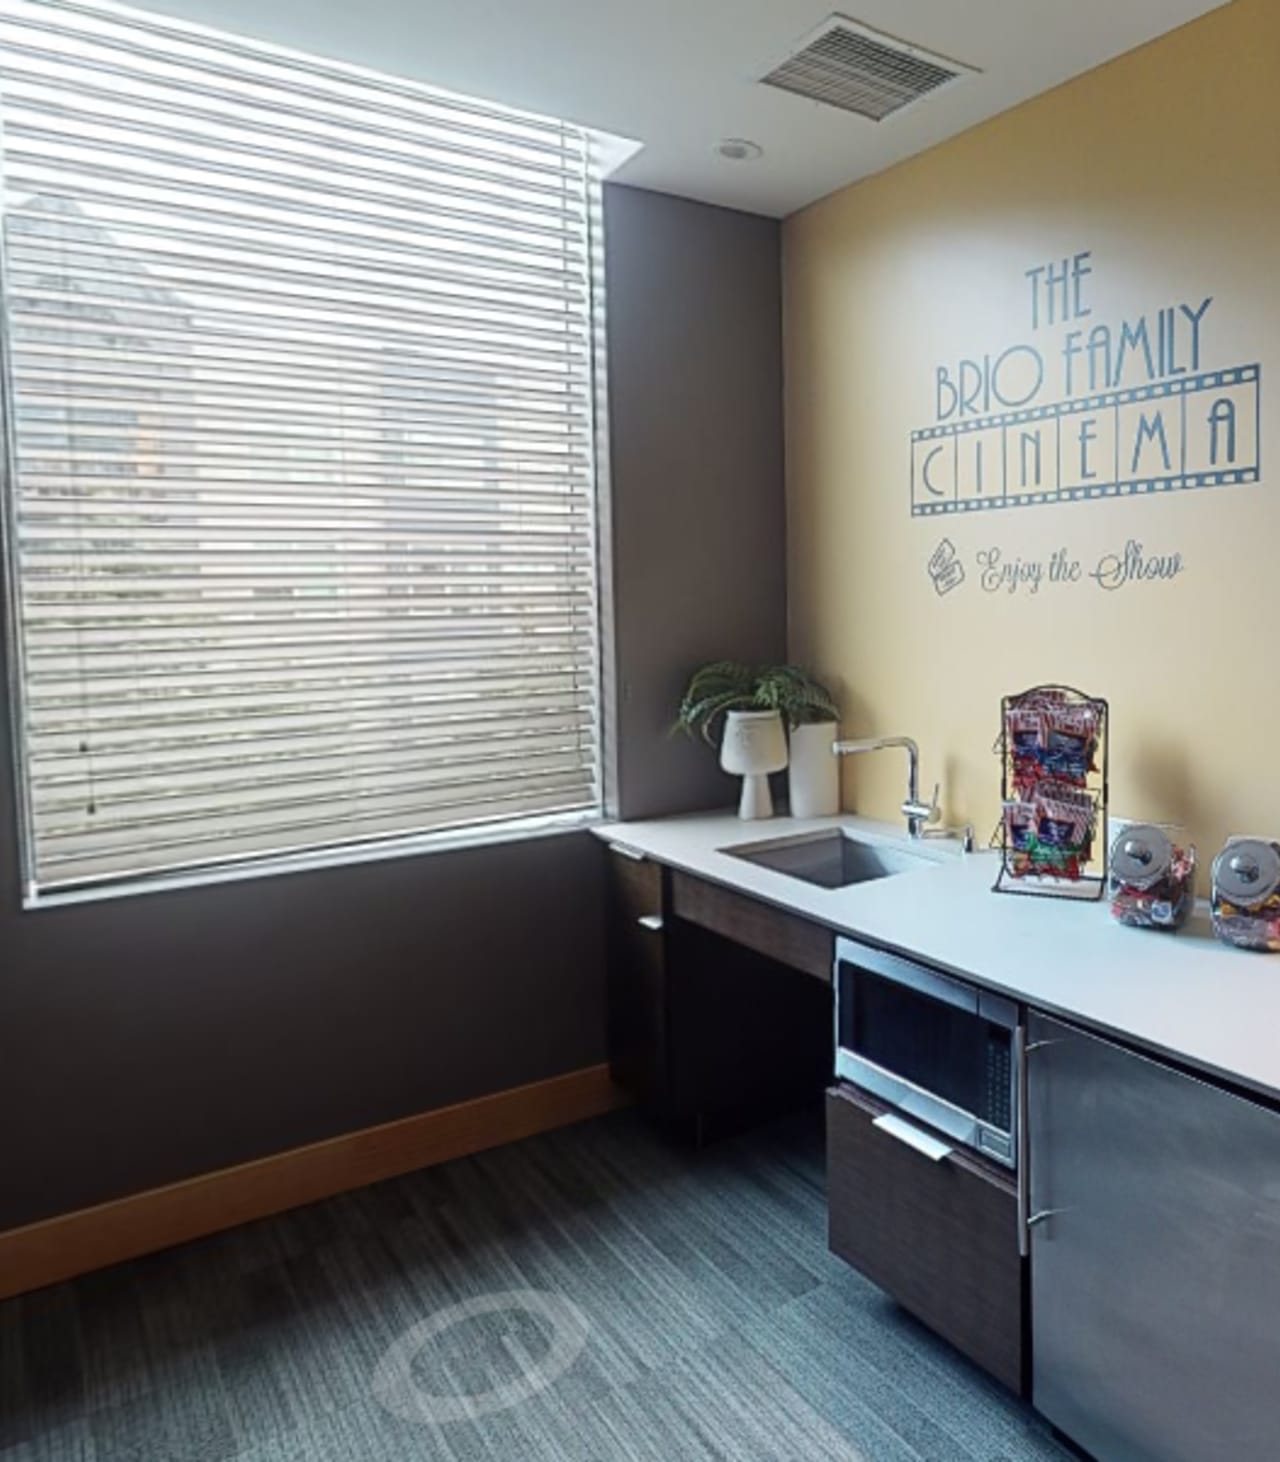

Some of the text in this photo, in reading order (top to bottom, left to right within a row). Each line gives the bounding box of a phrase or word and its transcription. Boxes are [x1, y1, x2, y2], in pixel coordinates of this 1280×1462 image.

[1025, 251, 1092, 329] THE
[936, 296, 1213, 421] BRIO FAMILY
[923, 397, 1237, 496] CINEMA
[976, 539, 1185, 594] Enjoy the Show
